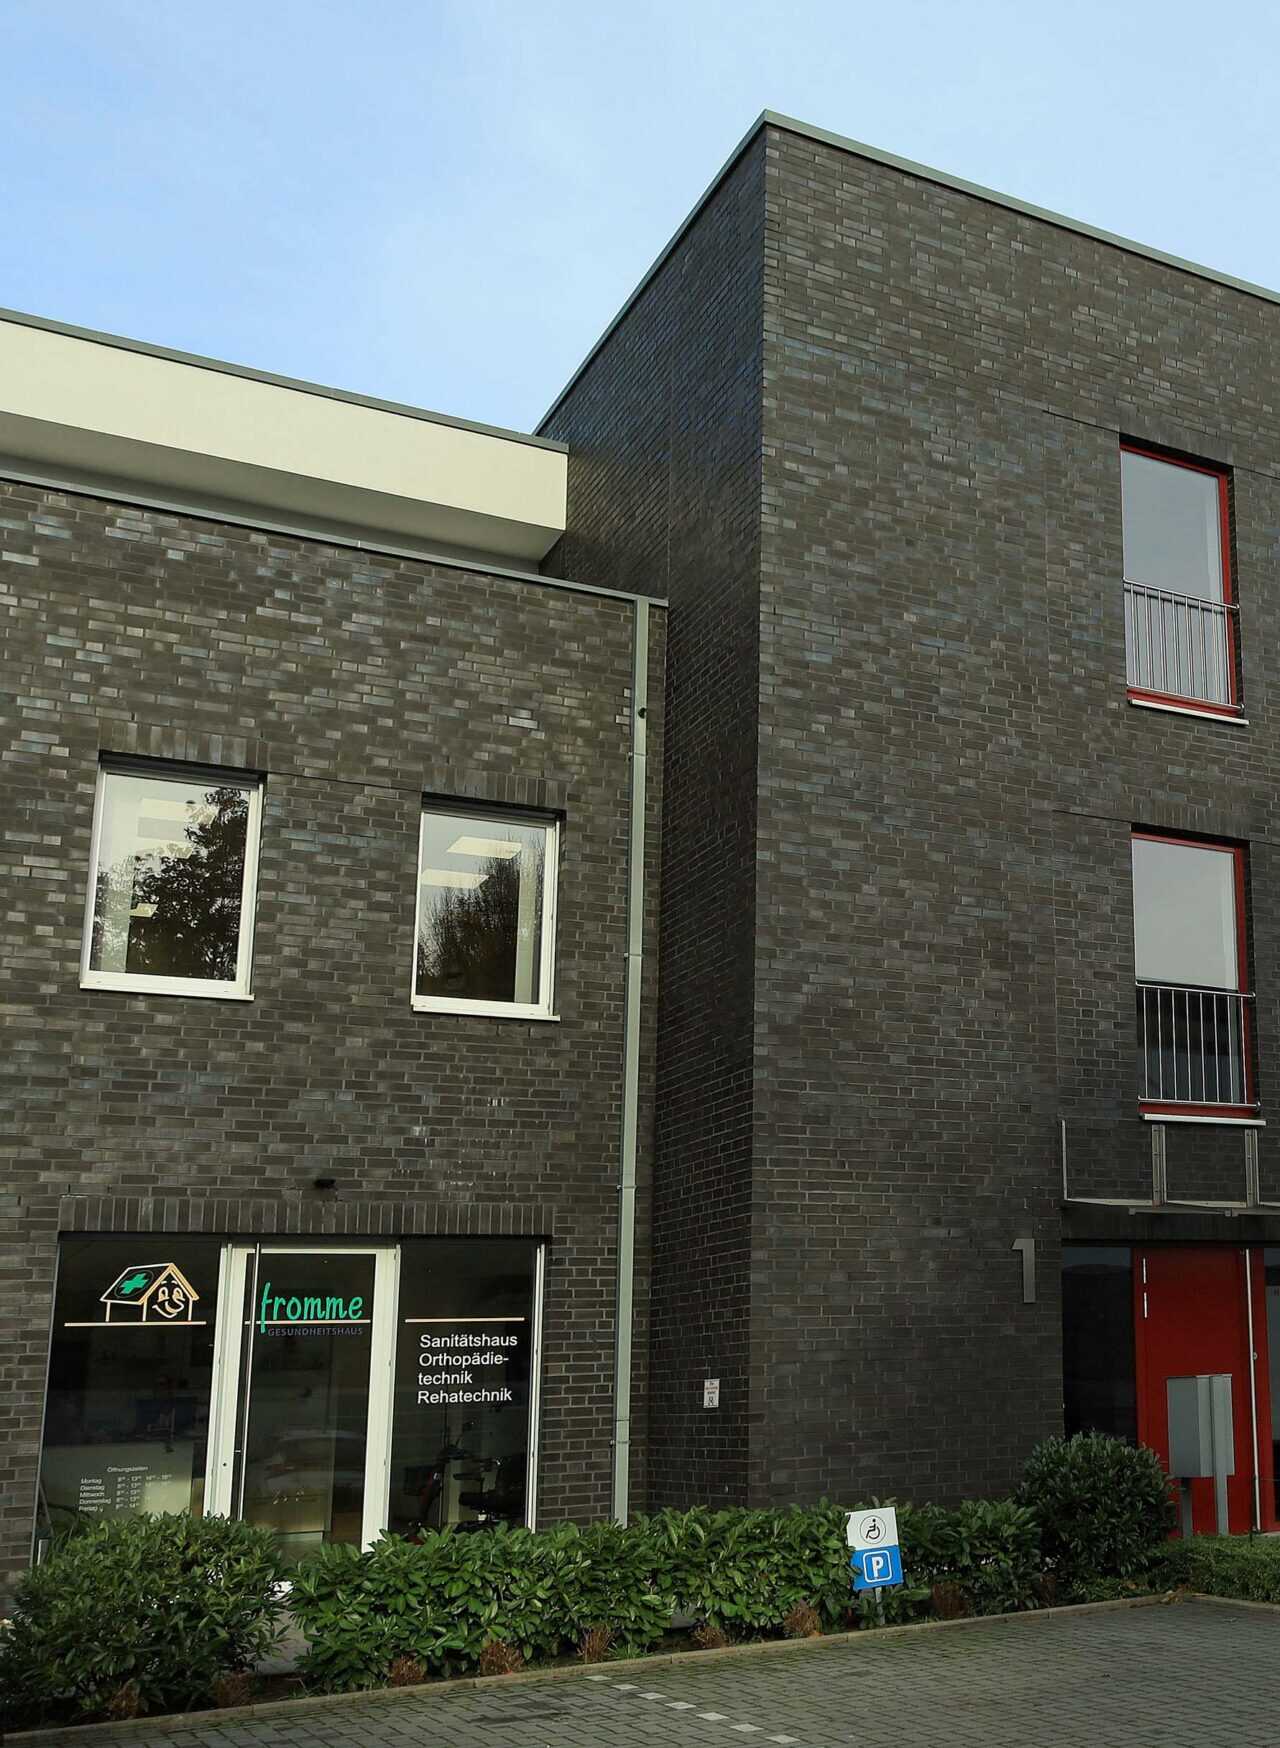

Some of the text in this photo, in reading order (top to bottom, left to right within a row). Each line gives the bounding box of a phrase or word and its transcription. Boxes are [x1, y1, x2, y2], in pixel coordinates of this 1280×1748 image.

[1012, 1238, 1035, 1303] 1
[261, 1282, 363, 1334] fromme
[267, 1327, 363, 1337] GESUNDHEITSHAUS
[420, 1333, 518, 1348] Sanitätshaus
[419, 1351, 509, 1369] Orthopädie-
[418, 1370, 473, 1385] technik
[417, 1387, 512, 1404] Rehatechnik
[871, 1556, 884, 1580] P
